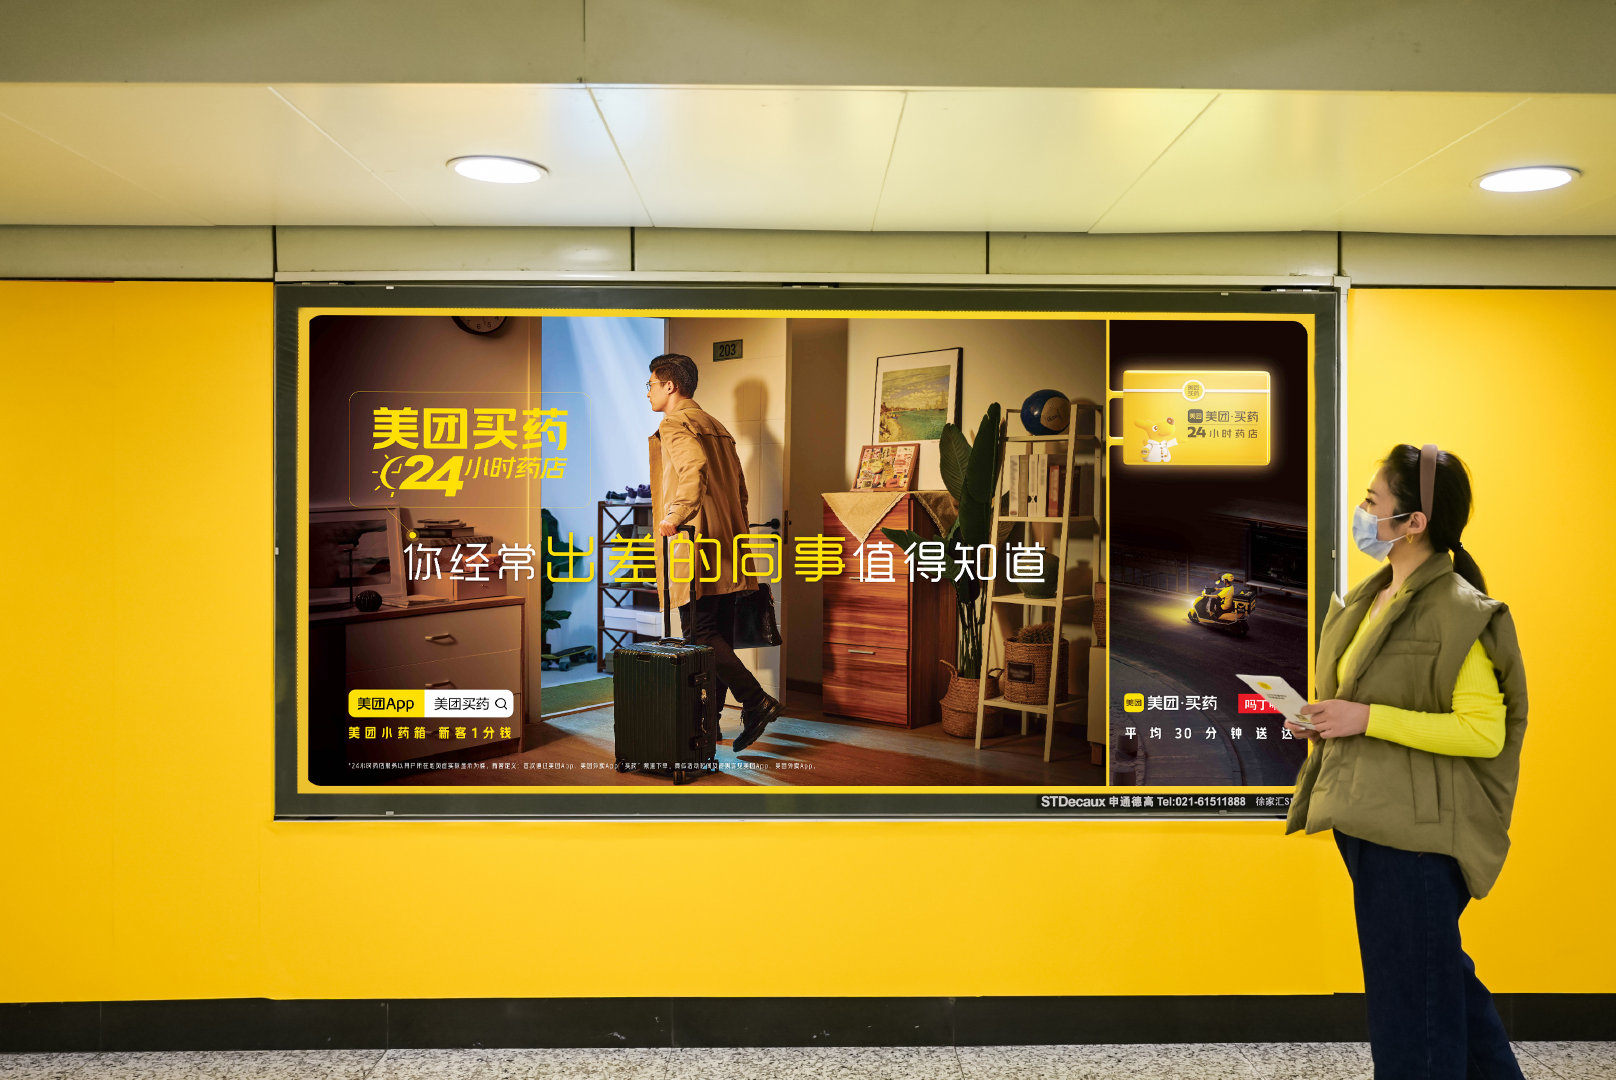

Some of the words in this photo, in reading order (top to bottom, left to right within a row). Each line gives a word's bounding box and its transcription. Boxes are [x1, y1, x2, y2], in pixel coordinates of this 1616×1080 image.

[719, 343, 736, 357] 203
[372, 406, 569, 451] 美团买药
[1187, 426, 1258, 439] 24小时药店
[398, 454, 568, 497] 24小时药店
[403, 531, 1046, 584] 你经常出差的同事值得知道
[357, 696, 415, 713] 美团App
[434, 697, 490, 711] 美团买药
[348, 726, 426, 740] 美团小药箱
[438, 726, 512, 740] 新客1分钱
[1041, 796, 1106, 808] STDecaux
[1109, 795, 1154, 808] 申通德高
[1157, 796, 1246, 807] Tel:021-61511888
